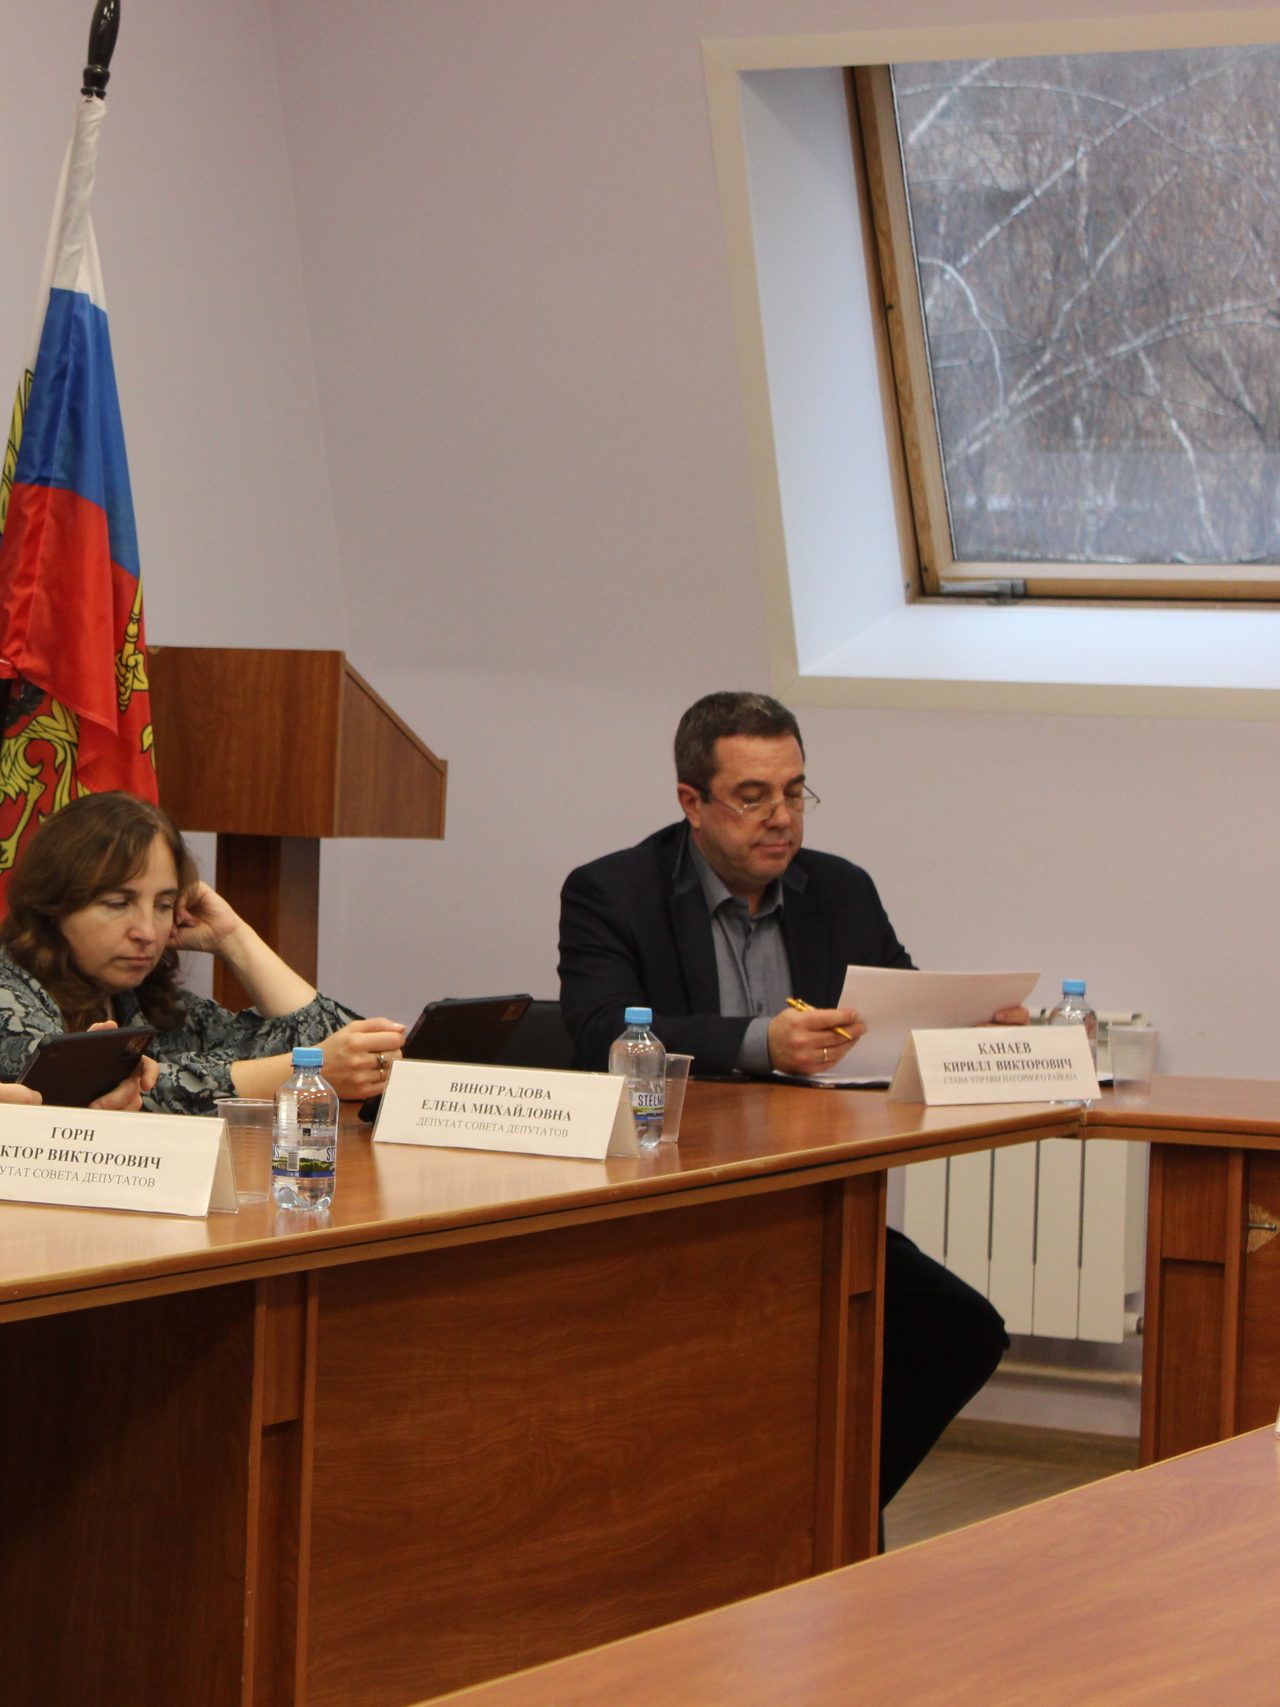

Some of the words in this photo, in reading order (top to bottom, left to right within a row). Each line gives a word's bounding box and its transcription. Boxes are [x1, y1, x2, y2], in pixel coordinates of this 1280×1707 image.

[978, 1042, 1032, 1055] КАНАЕВ
[943, 1060, 991, 1072] КИРИЛЛ
[996, 1058, 1072, 1071] ВИКТОРОВИЧ
[450, 1082, 552, 1100] ВИНОГРАДОВА
[421, 1099, 467, 1113] ЕЛЕНА
[470, 1103, 572, 1122] МИХАЙЛОВНА
[50, 1126, 95, 1142] ГОРН
[416, 1117, 463, 1130] ДЕПУТАТ
[465, 1121, 504, 1133] СОВЕТА
[506, 1124, 568, 1138] ДЕПУТАТОВ
[47, 1148, 162, 1170] ВИКТОРОВИЧ
[32, 1168, 79, 1182] СОВЕТА
[82, 1172, 156, 1188] ДЕПУТАТОВ
